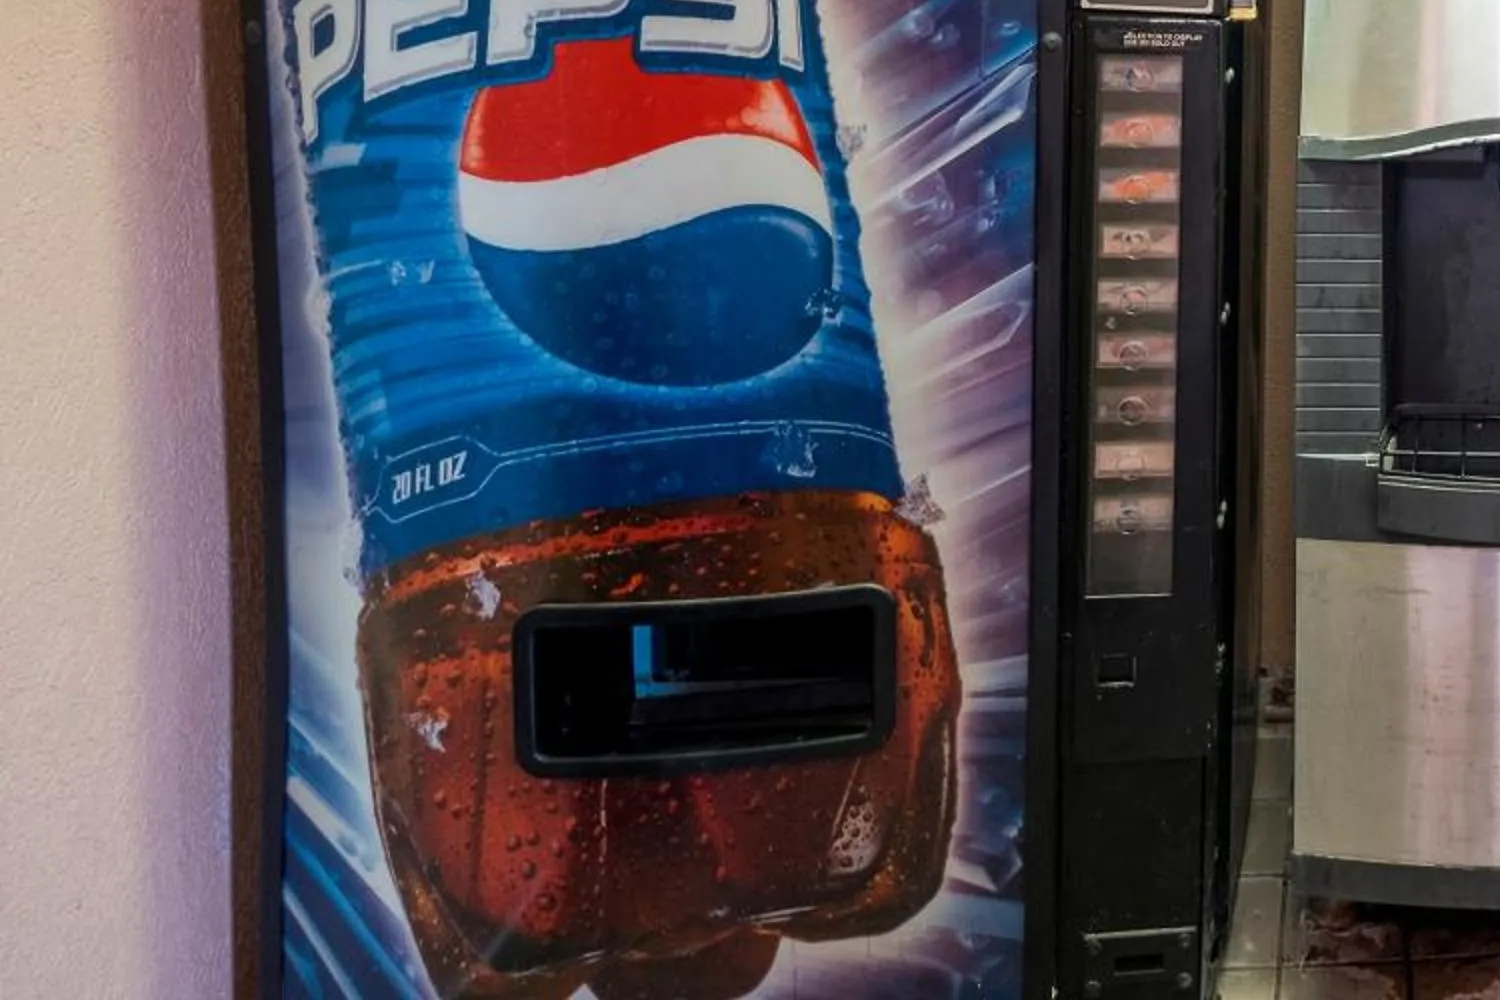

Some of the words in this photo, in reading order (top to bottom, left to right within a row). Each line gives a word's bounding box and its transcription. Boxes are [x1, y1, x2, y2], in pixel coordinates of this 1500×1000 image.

[392, 470, 412, 505] 20
[415, 462, 435, 495] FL
[439, 450, 468, 487] OZ
